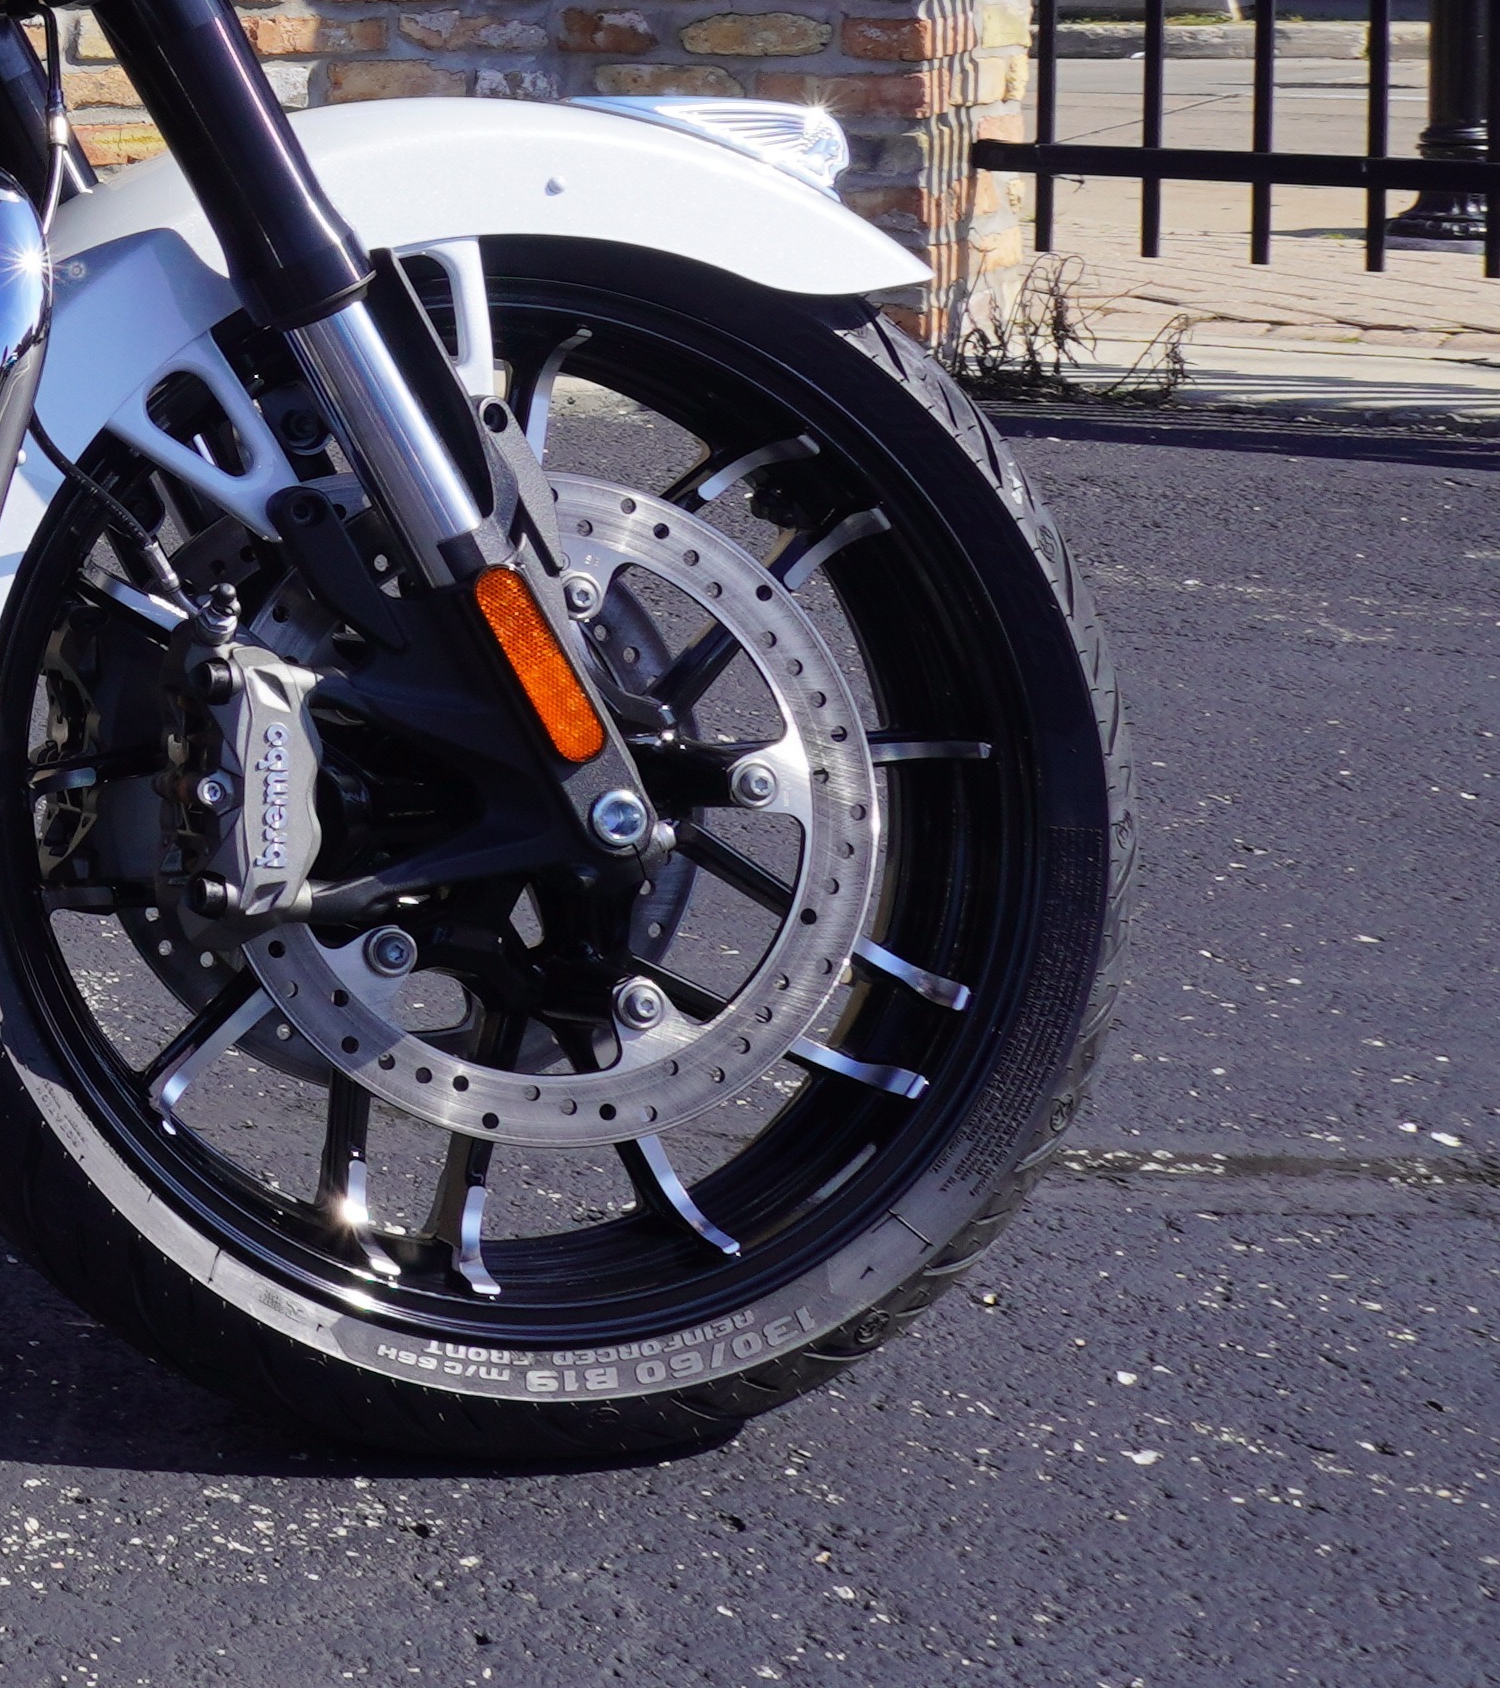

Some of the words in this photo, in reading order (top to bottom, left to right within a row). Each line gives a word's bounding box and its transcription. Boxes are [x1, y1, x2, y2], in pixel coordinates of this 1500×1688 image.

[252, 720, 290, 870] brembo
[375, 1342, 438, 1371] 66H
[419, 1338, 535, 1367] FRONT
[551, 1308, 755, 1367] REINFORCED
[632, 1304, 816, 1386] 130/60
[524, 1365, 619, 1394] B19
